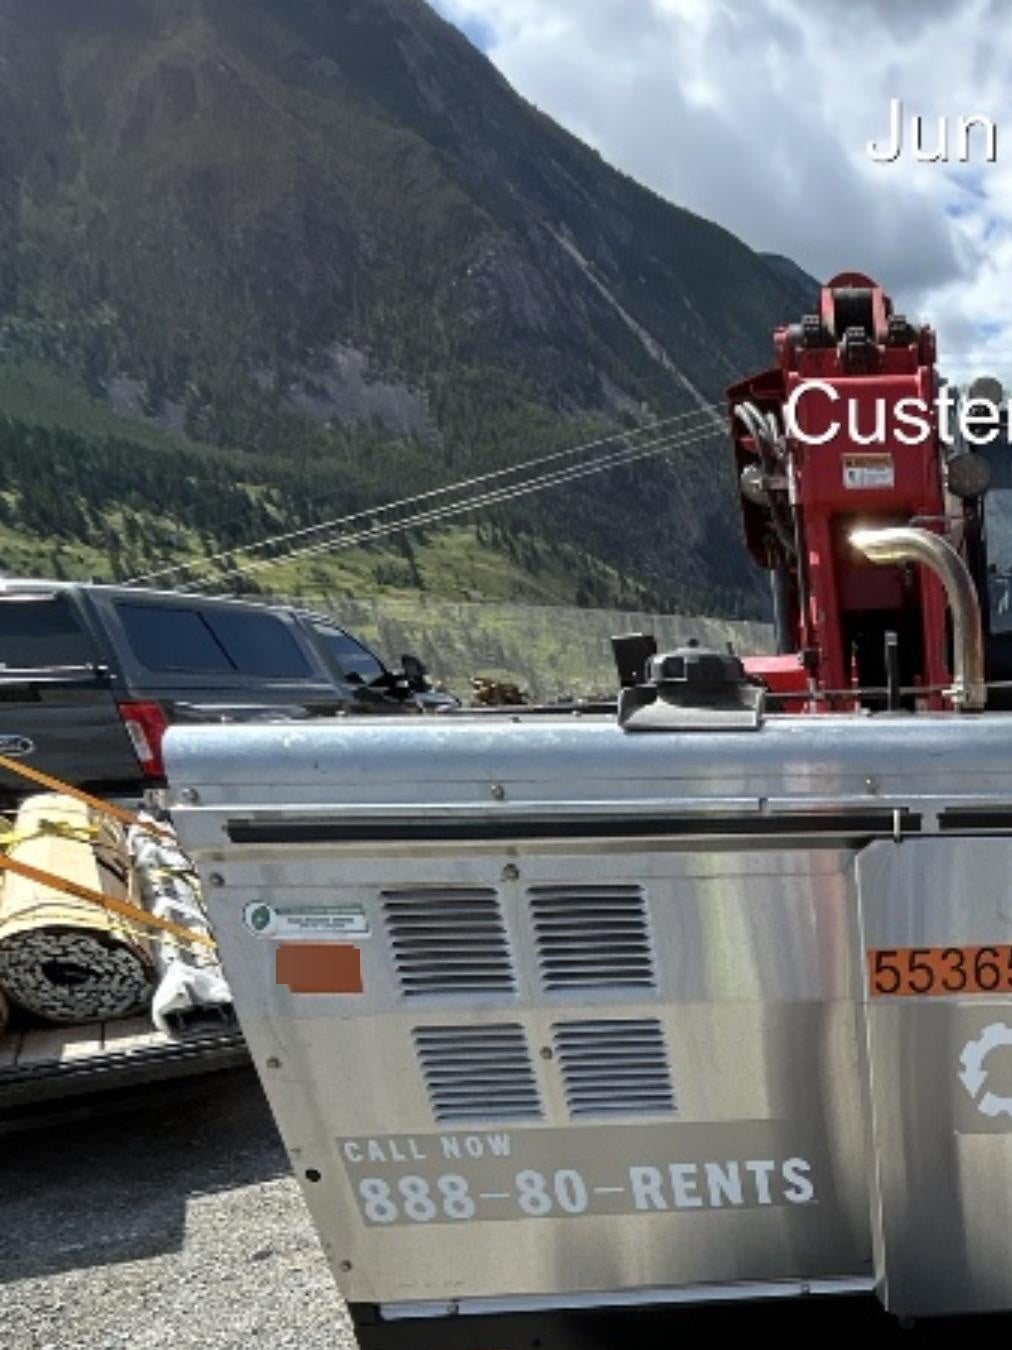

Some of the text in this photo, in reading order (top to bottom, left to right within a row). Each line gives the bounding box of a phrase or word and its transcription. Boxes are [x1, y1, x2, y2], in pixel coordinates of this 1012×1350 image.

[344, 1133, 511, 1163] CALL NOW
[358, 1156, 816, 1223] 888-80-RENTS
